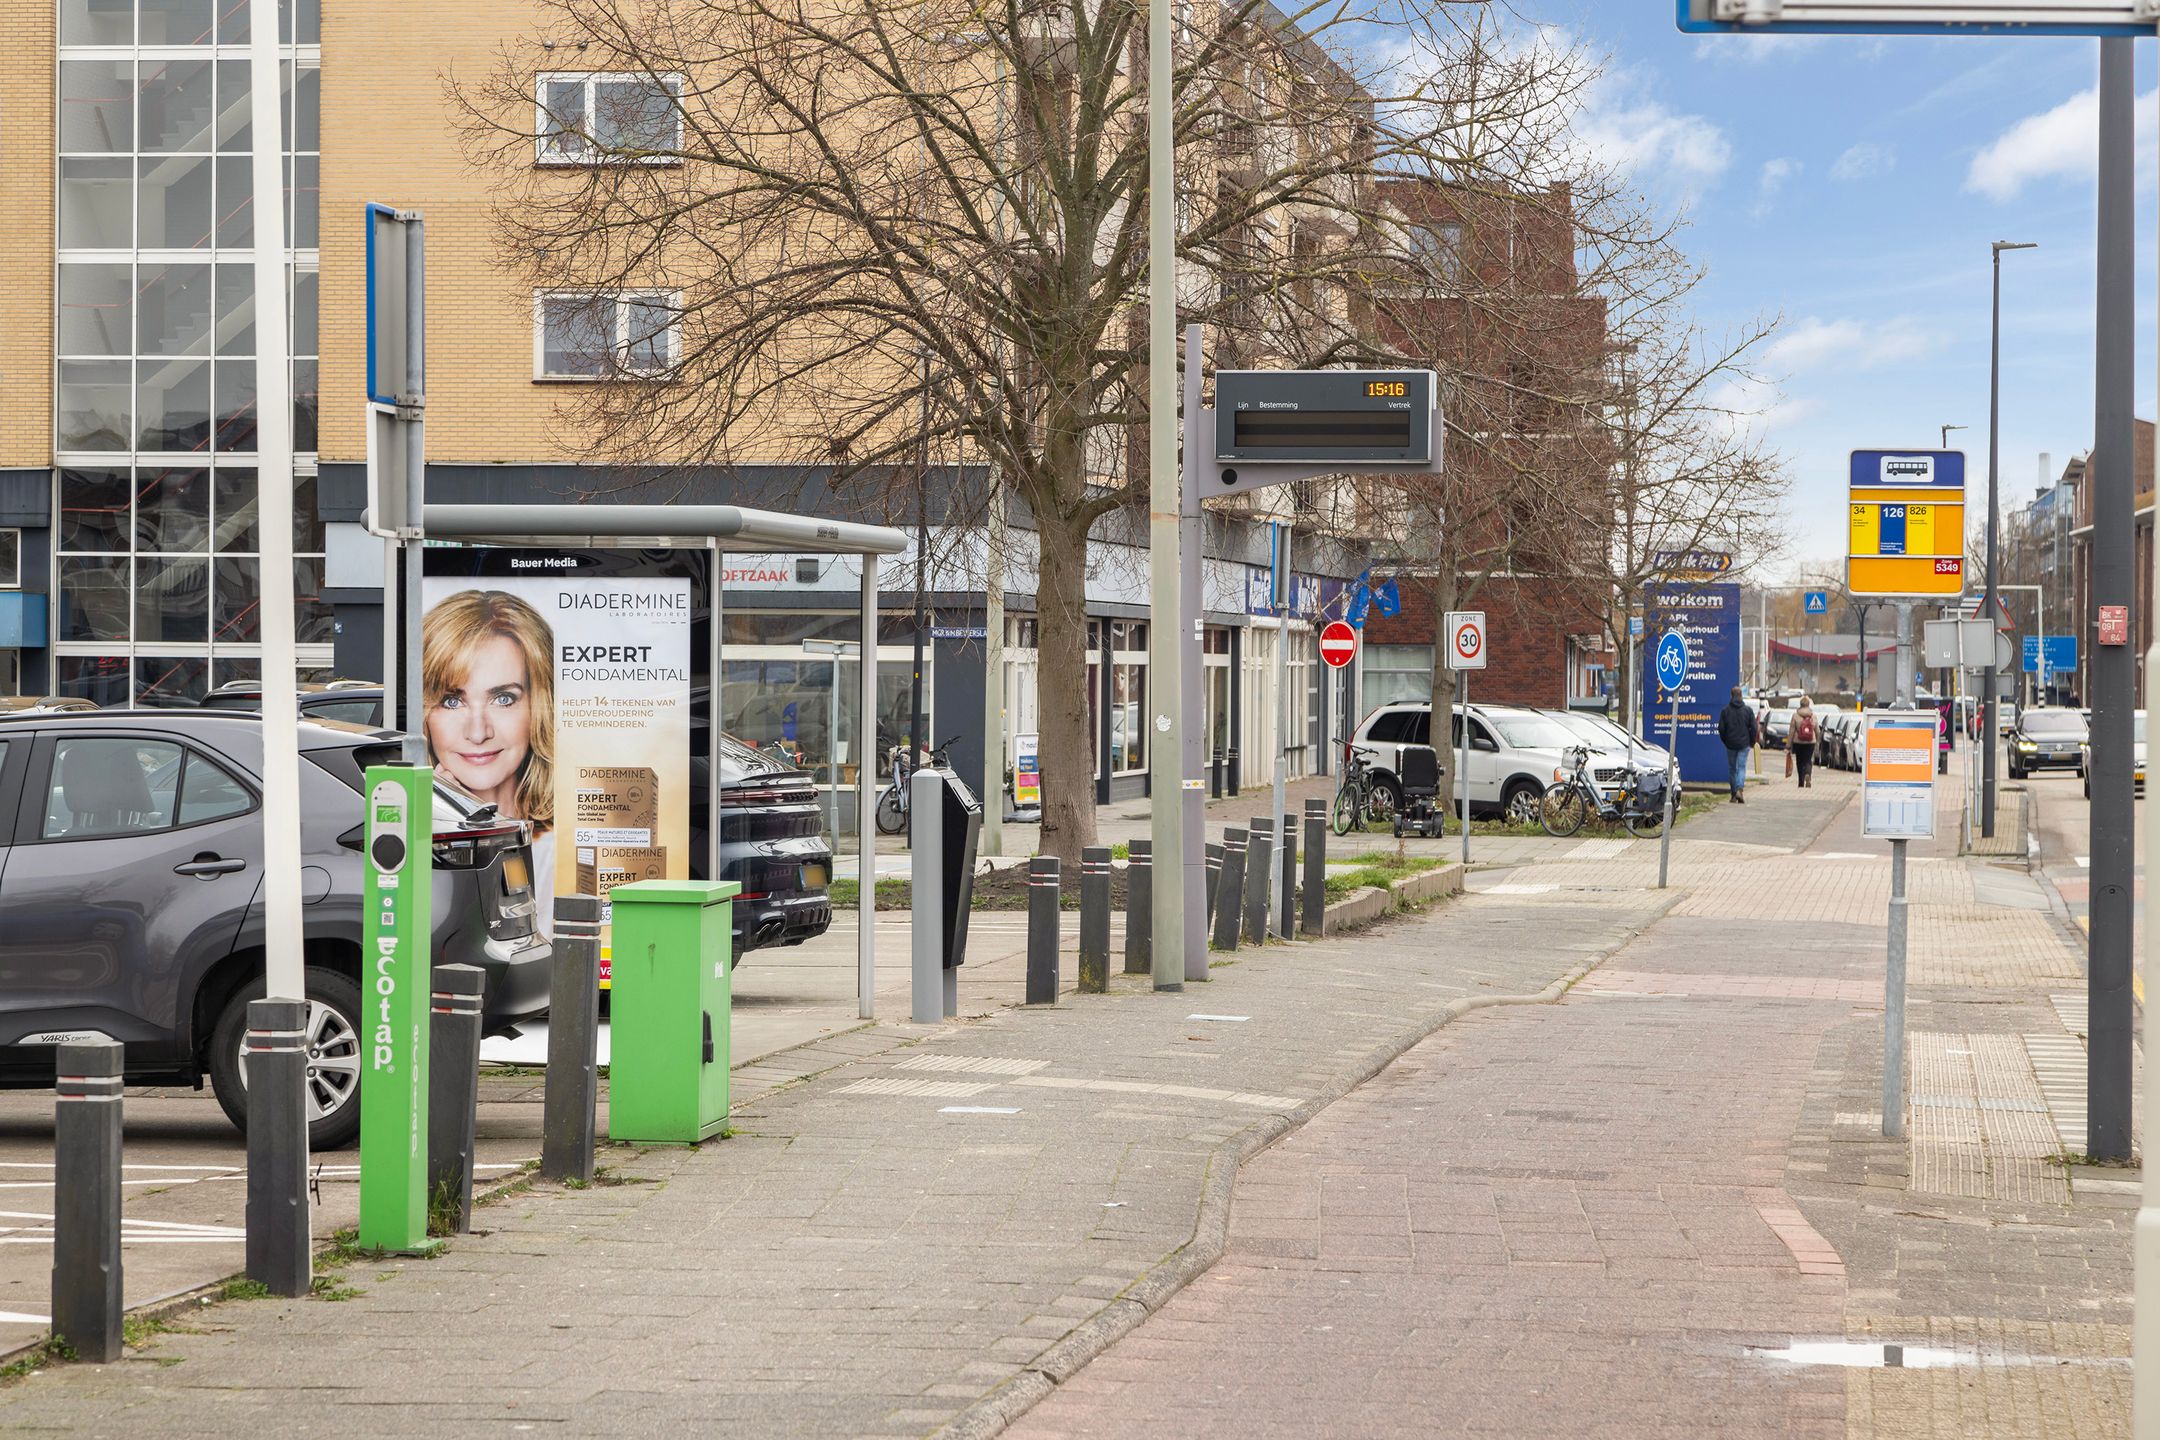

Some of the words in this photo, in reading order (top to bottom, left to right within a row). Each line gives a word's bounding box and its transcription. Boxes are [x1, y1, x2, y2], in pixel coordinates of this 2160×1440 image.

[1368, 382, 1404, 396] 15:16
[1237, 401, 1249, 410] Lijn
[1259, 401, 1299, 410] Bestemming
[1388, 401, 1411, 409] Vertrek
[1853, 506, 1866, 515] 34
[1882, 507, 1904, 518] 126
[1909, 506, 1927, 515] 826
[511, 558, 543, 568] Bauer
[544, 557, 578, 567] Media
[1935, 563, 1958, 572] 5349
[558, 592, 687, 609] DIADERMINE
[1669, 614, 1689, 622] APK
[1461, 634, 1477, 647] 30
[561, 646, 652, 663] EXPERT
[561, 668, 688, 681] FONDAMENTAL
[562, 699, 592, 707] HELPT
[594, 696, 609, 707] 14
[611, 699, 654, 707] TEKENEN
[656, 699, 676, 707] VAN
[1667, 695, 1697, 703] acu's
[562, 709, 655, 718] HUIDVEROUDERING
[562, 720, 574, 728] TE
[576, 720, 648, 728] VERMINDEREN.
[579, 768, 646, 779] DIADERMINE
[577, 793, 618, 803] EXPERT
[602, 848, 663, 858] DIADERMINE
[599, 873, 637, 882] EXPERT
[374, 939, 397, 1071] ecotap
[41, 1034, 71, 1043] YARIS
